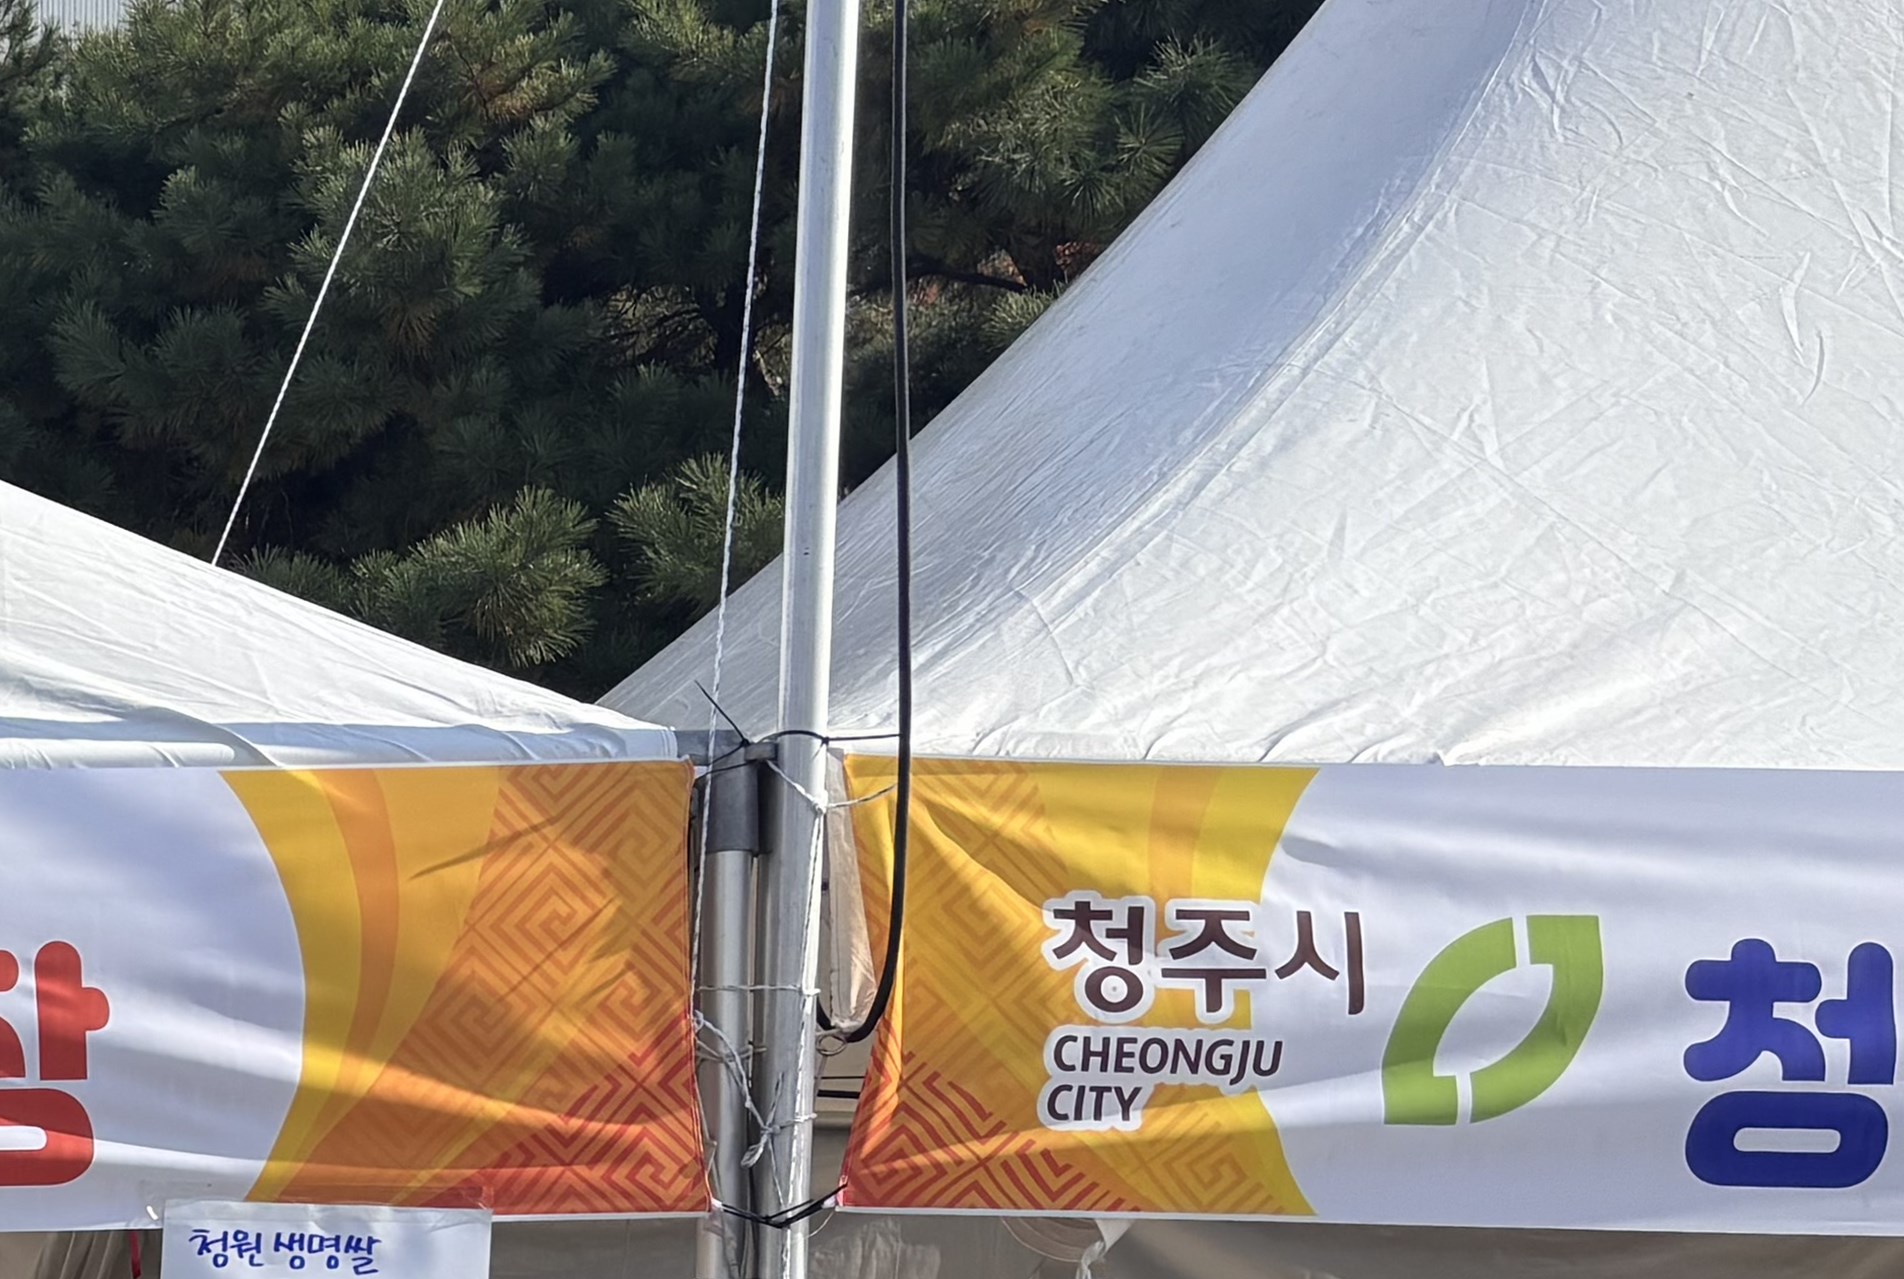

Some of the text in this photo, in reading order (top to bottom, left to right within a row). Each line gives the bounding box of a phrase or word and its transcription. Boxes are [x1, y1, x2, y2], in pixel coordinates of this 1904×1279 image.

[1052, 902, 1366, 1017] 청주시
[1054, 1033, 1283, 1078] CHEONGJU
[1046, 1084, 1140, 1123] CITY
[189, 1228, 382, 1276] 청원 생명쌀
